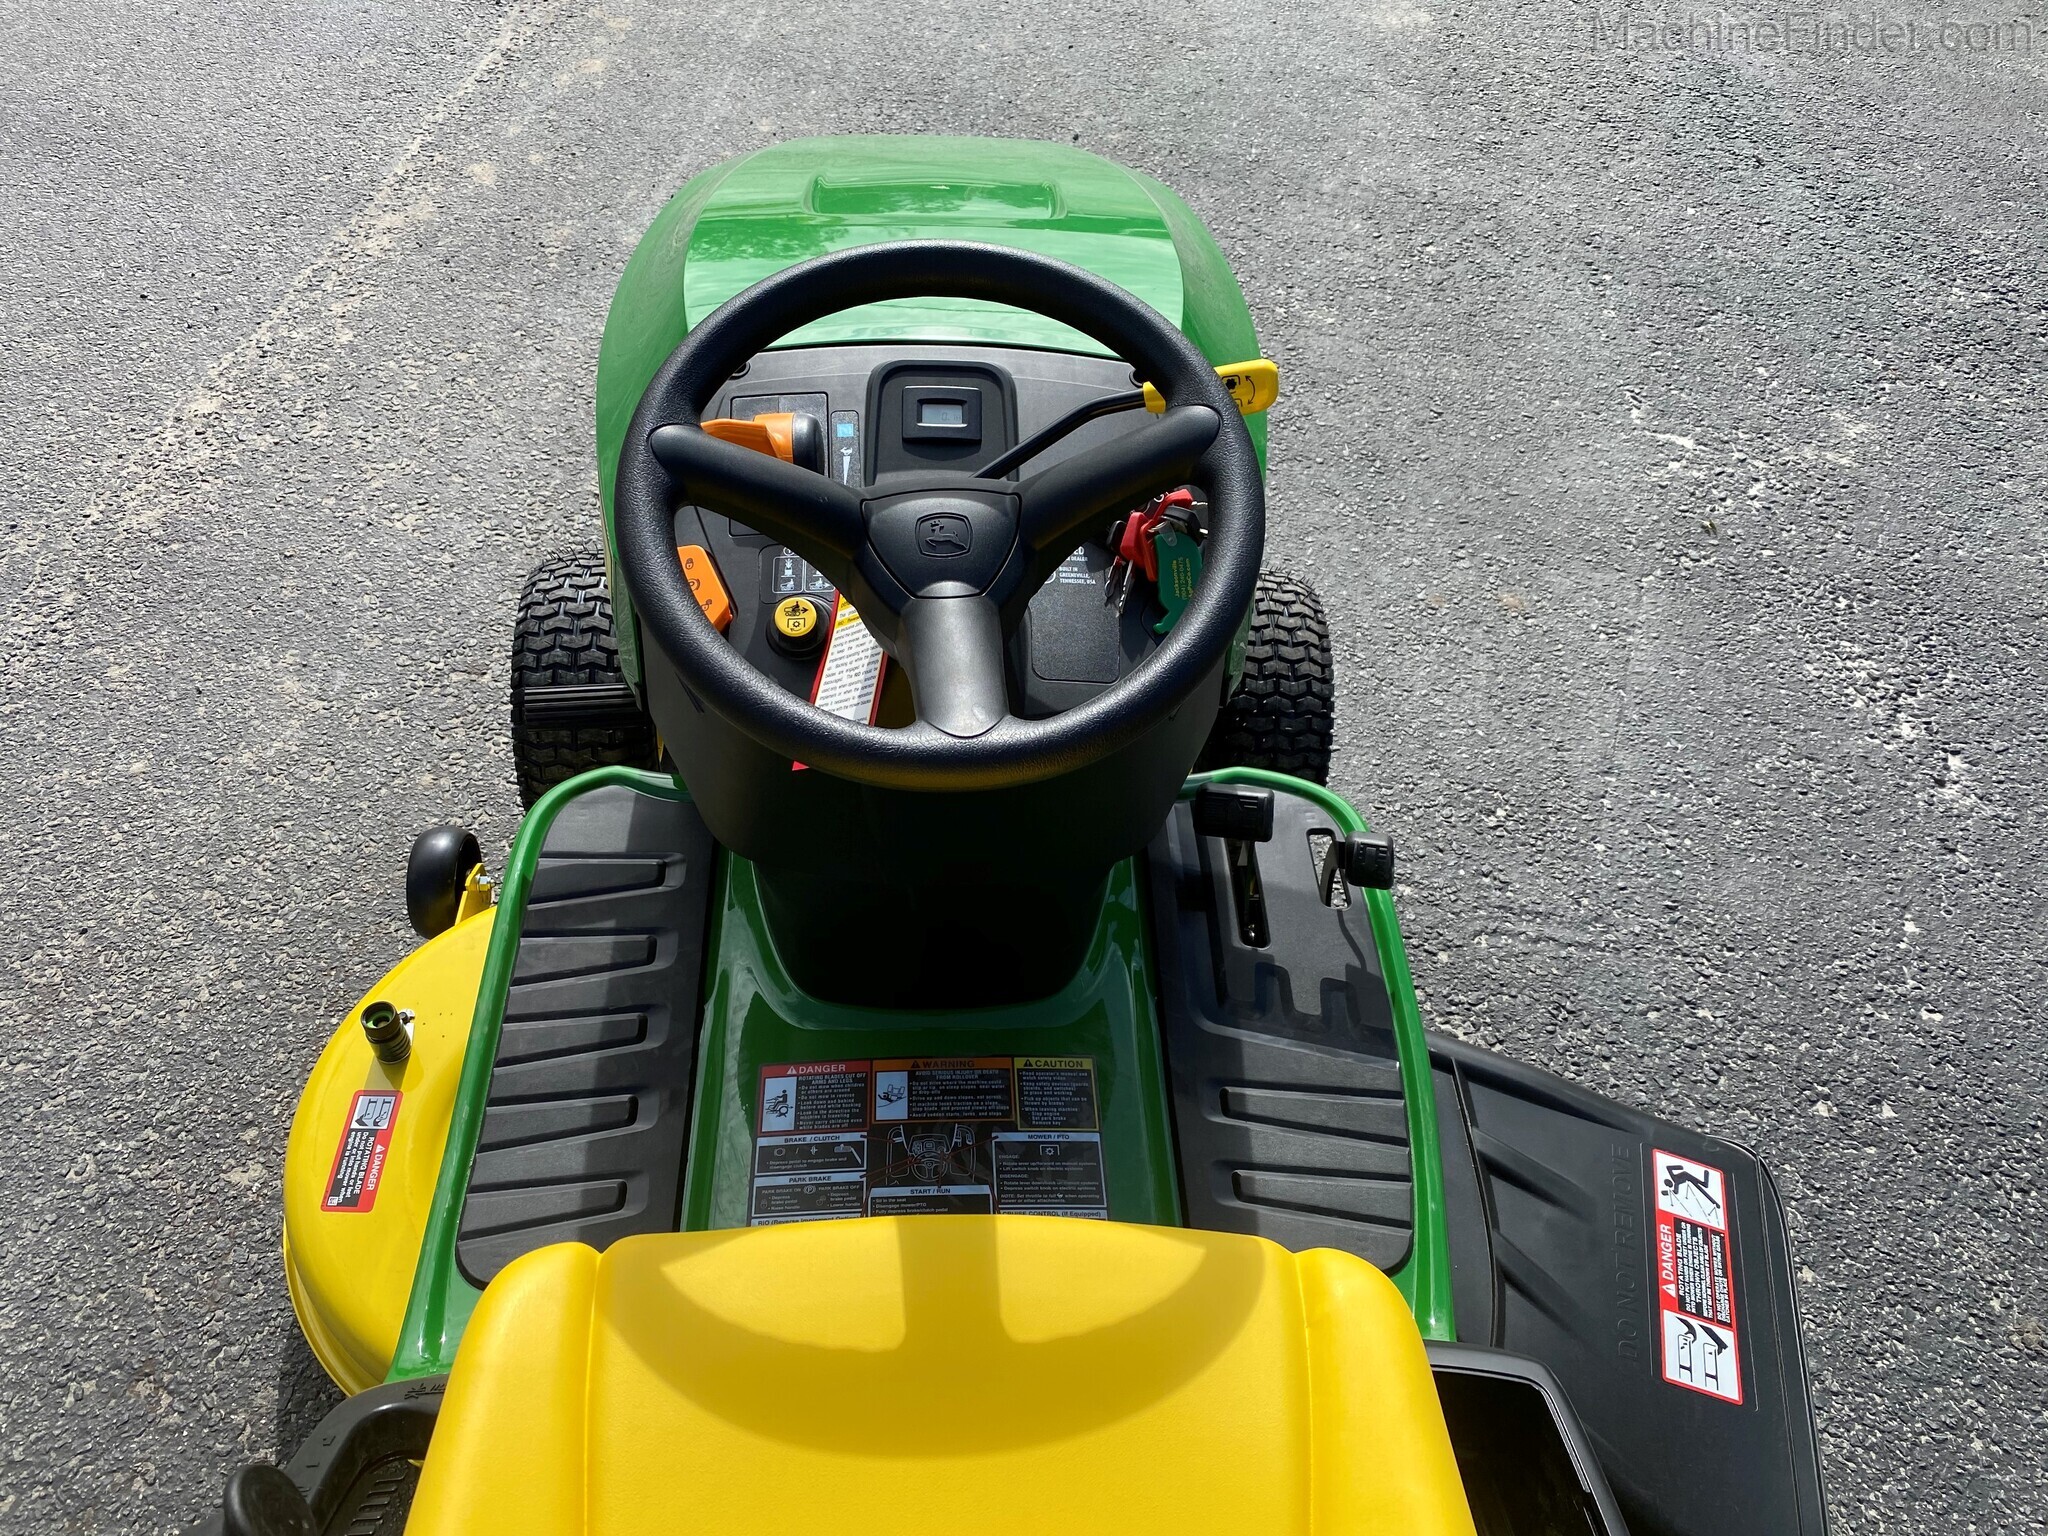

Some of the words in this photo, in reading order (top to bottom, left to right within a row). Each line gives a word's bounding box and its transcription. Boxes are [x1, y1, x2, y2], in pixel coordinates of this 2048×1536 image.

[799, 1064, 846, 1074] DANGER
[922, 1060, 974, 1068] WARNING
[360, 1137, 375, 1170] ROTATING
[354, 1171, 365, 1194] BLADE
[367, 1154, 382, 1190] DANGER
[1611, 1143, 1634, 1249] REMOVE
[1660, 1224, 1674, 1281] DANGER
[1615, 1252, 1636, 1313] NOT
[1676, 1258, 1684, 1296] ROTATING
[1694, 1270, 1702, 1302] THROWN
[1616, 1318, 1638, 1359] DO
